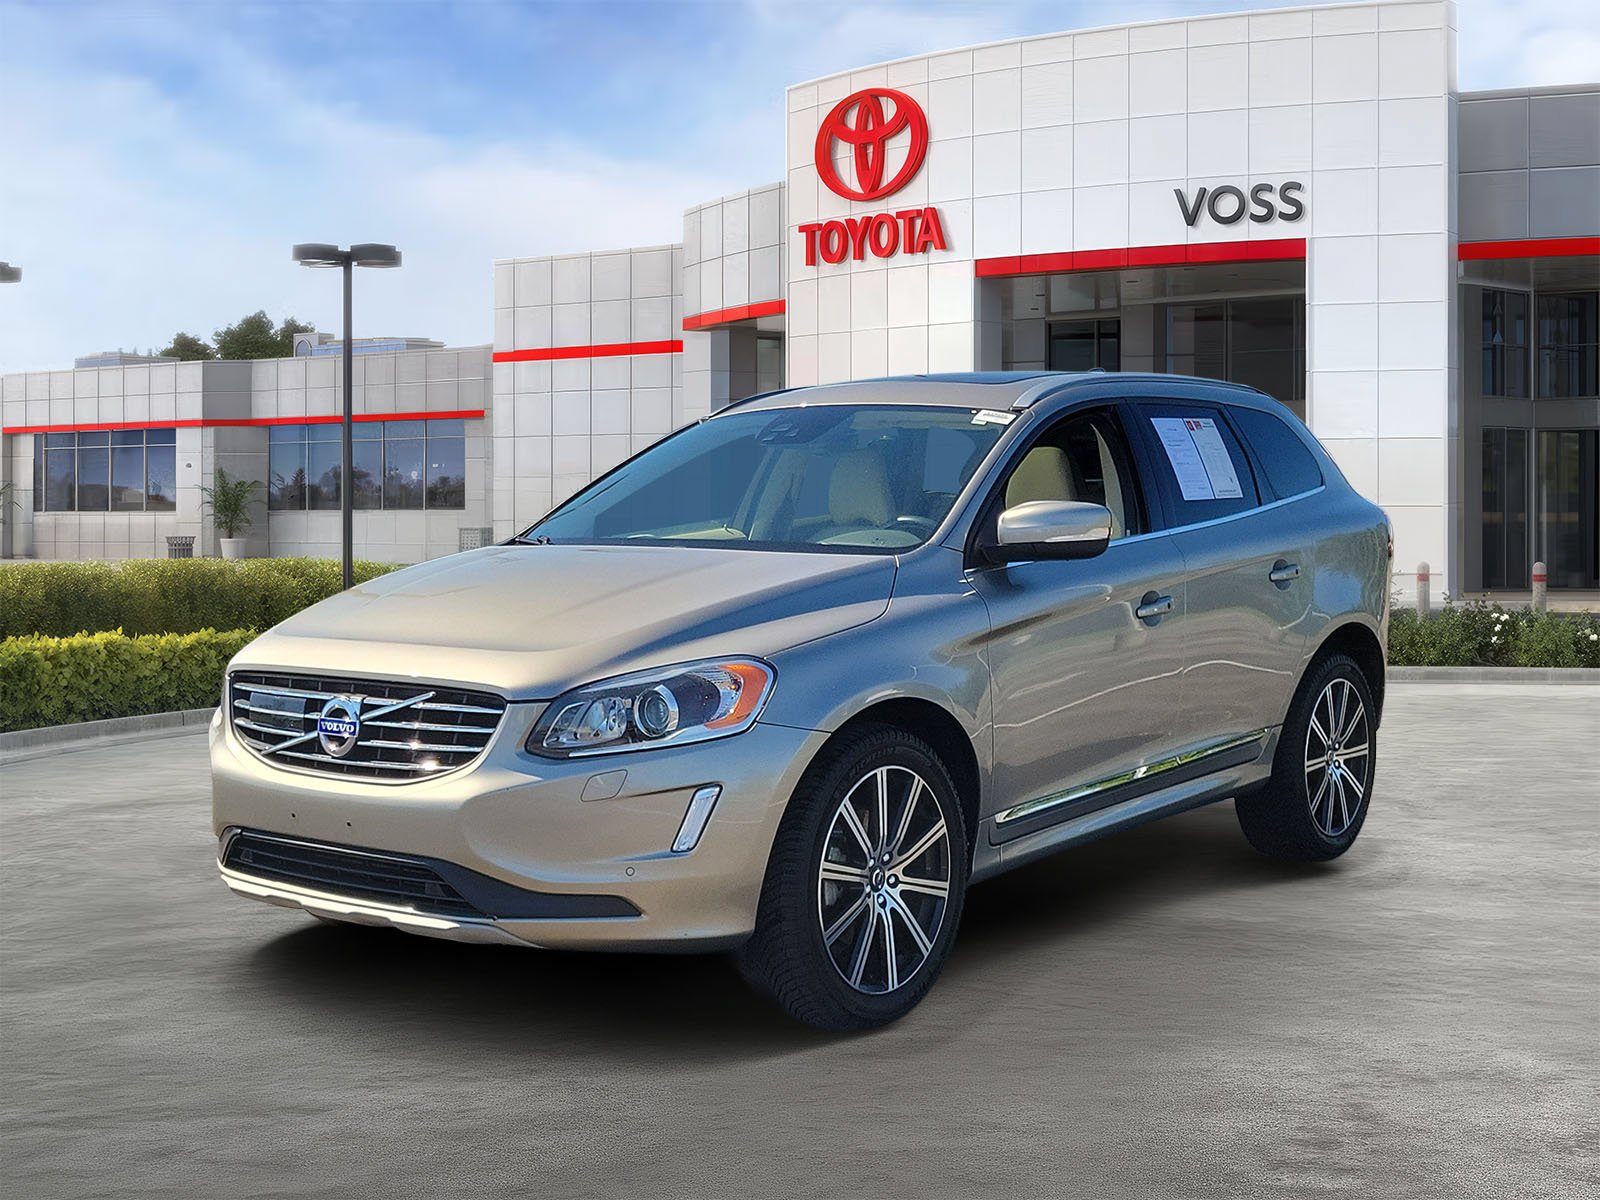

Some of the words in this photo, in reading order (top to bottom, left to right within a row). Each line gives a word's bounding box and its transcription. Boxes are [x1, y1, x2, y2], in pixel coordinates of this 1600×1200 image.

[1173, 181, 1304, 226] VOSS
[798, 207, 947, 266] TOYOTA
[321, 722, 354, 732] VOLVO
